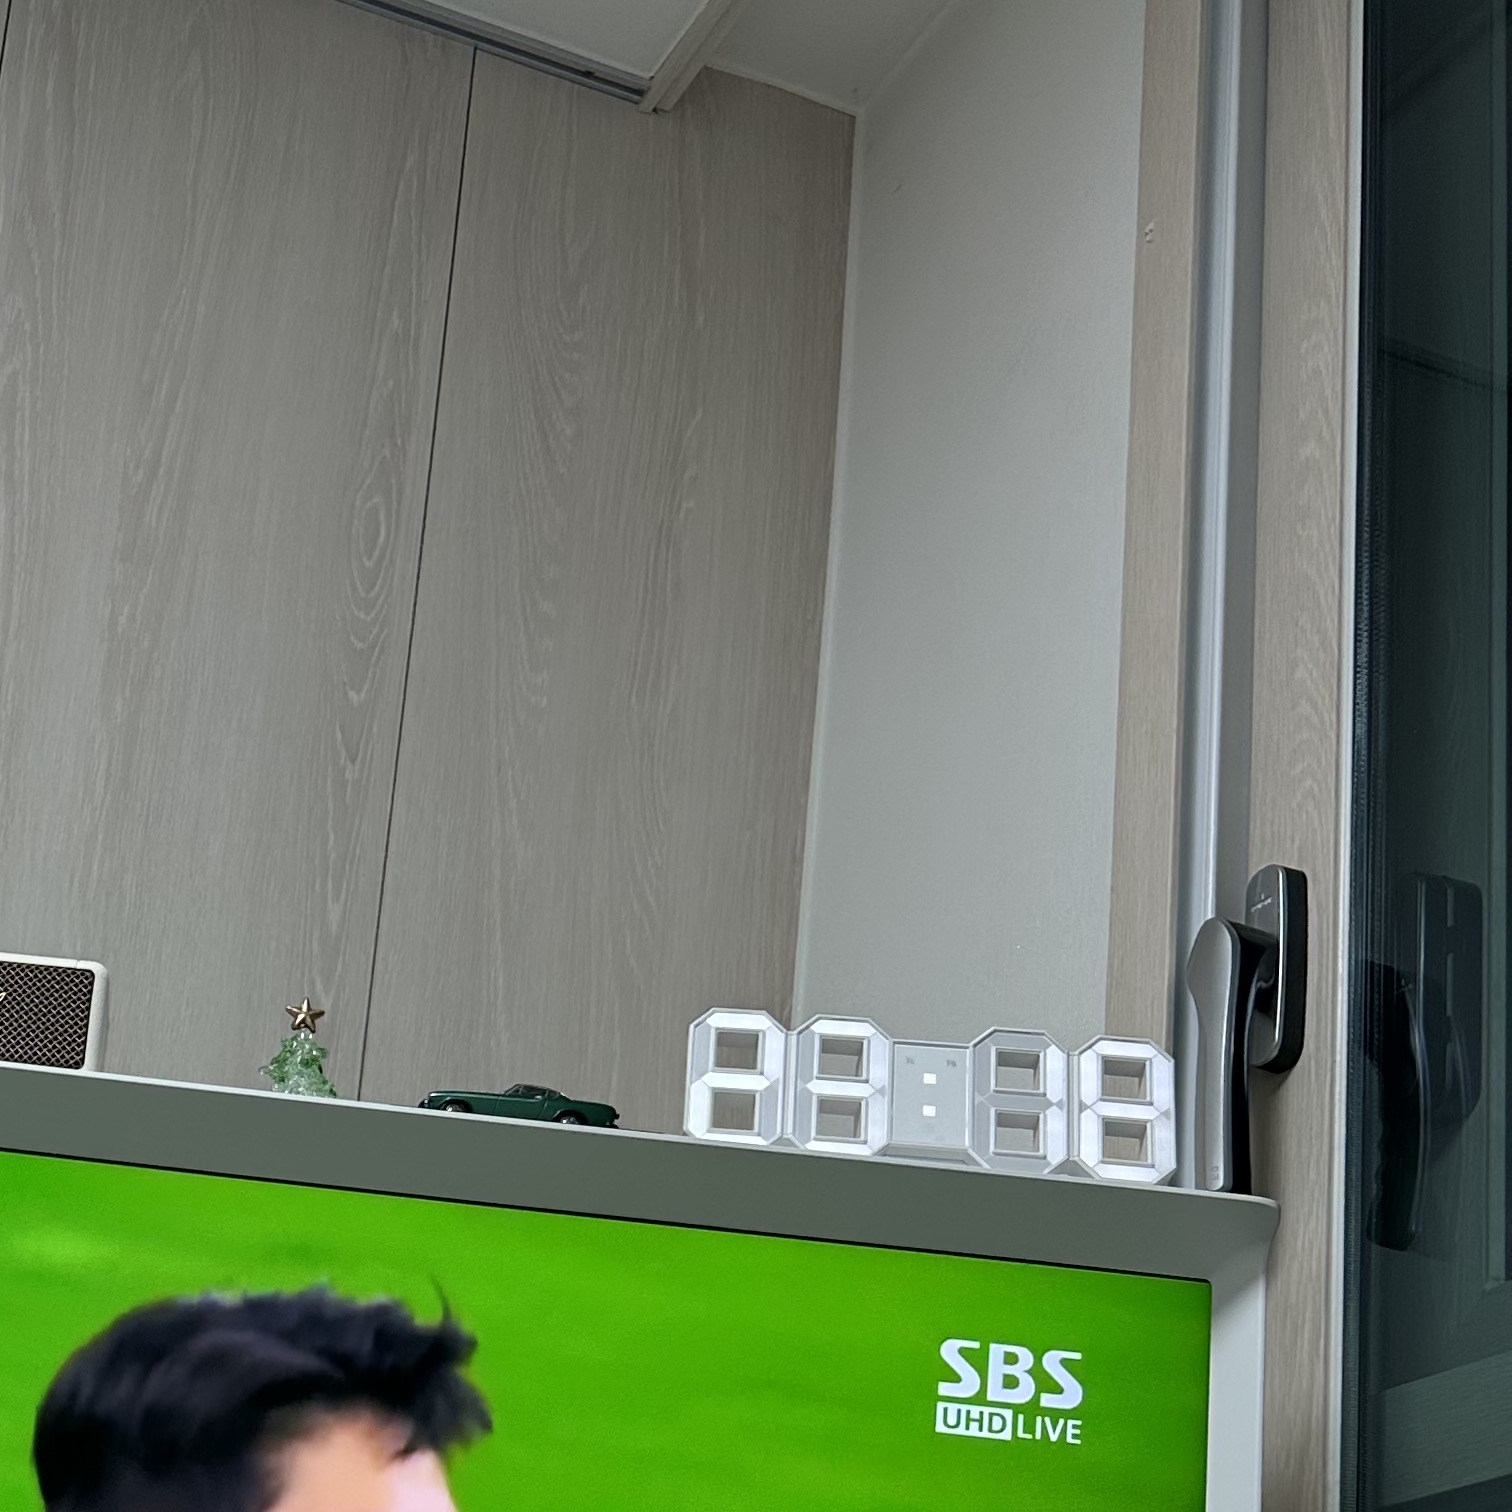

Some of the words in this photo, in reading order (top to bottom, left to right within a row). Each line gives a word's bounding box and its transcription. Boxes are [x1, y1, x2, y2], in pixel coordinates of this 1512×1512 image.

[937, 1338, 1083, 1410] SBS
[942, 1406, 1008, 1434] UHD
[1017, 1413, 1082, 1445] LIVE
